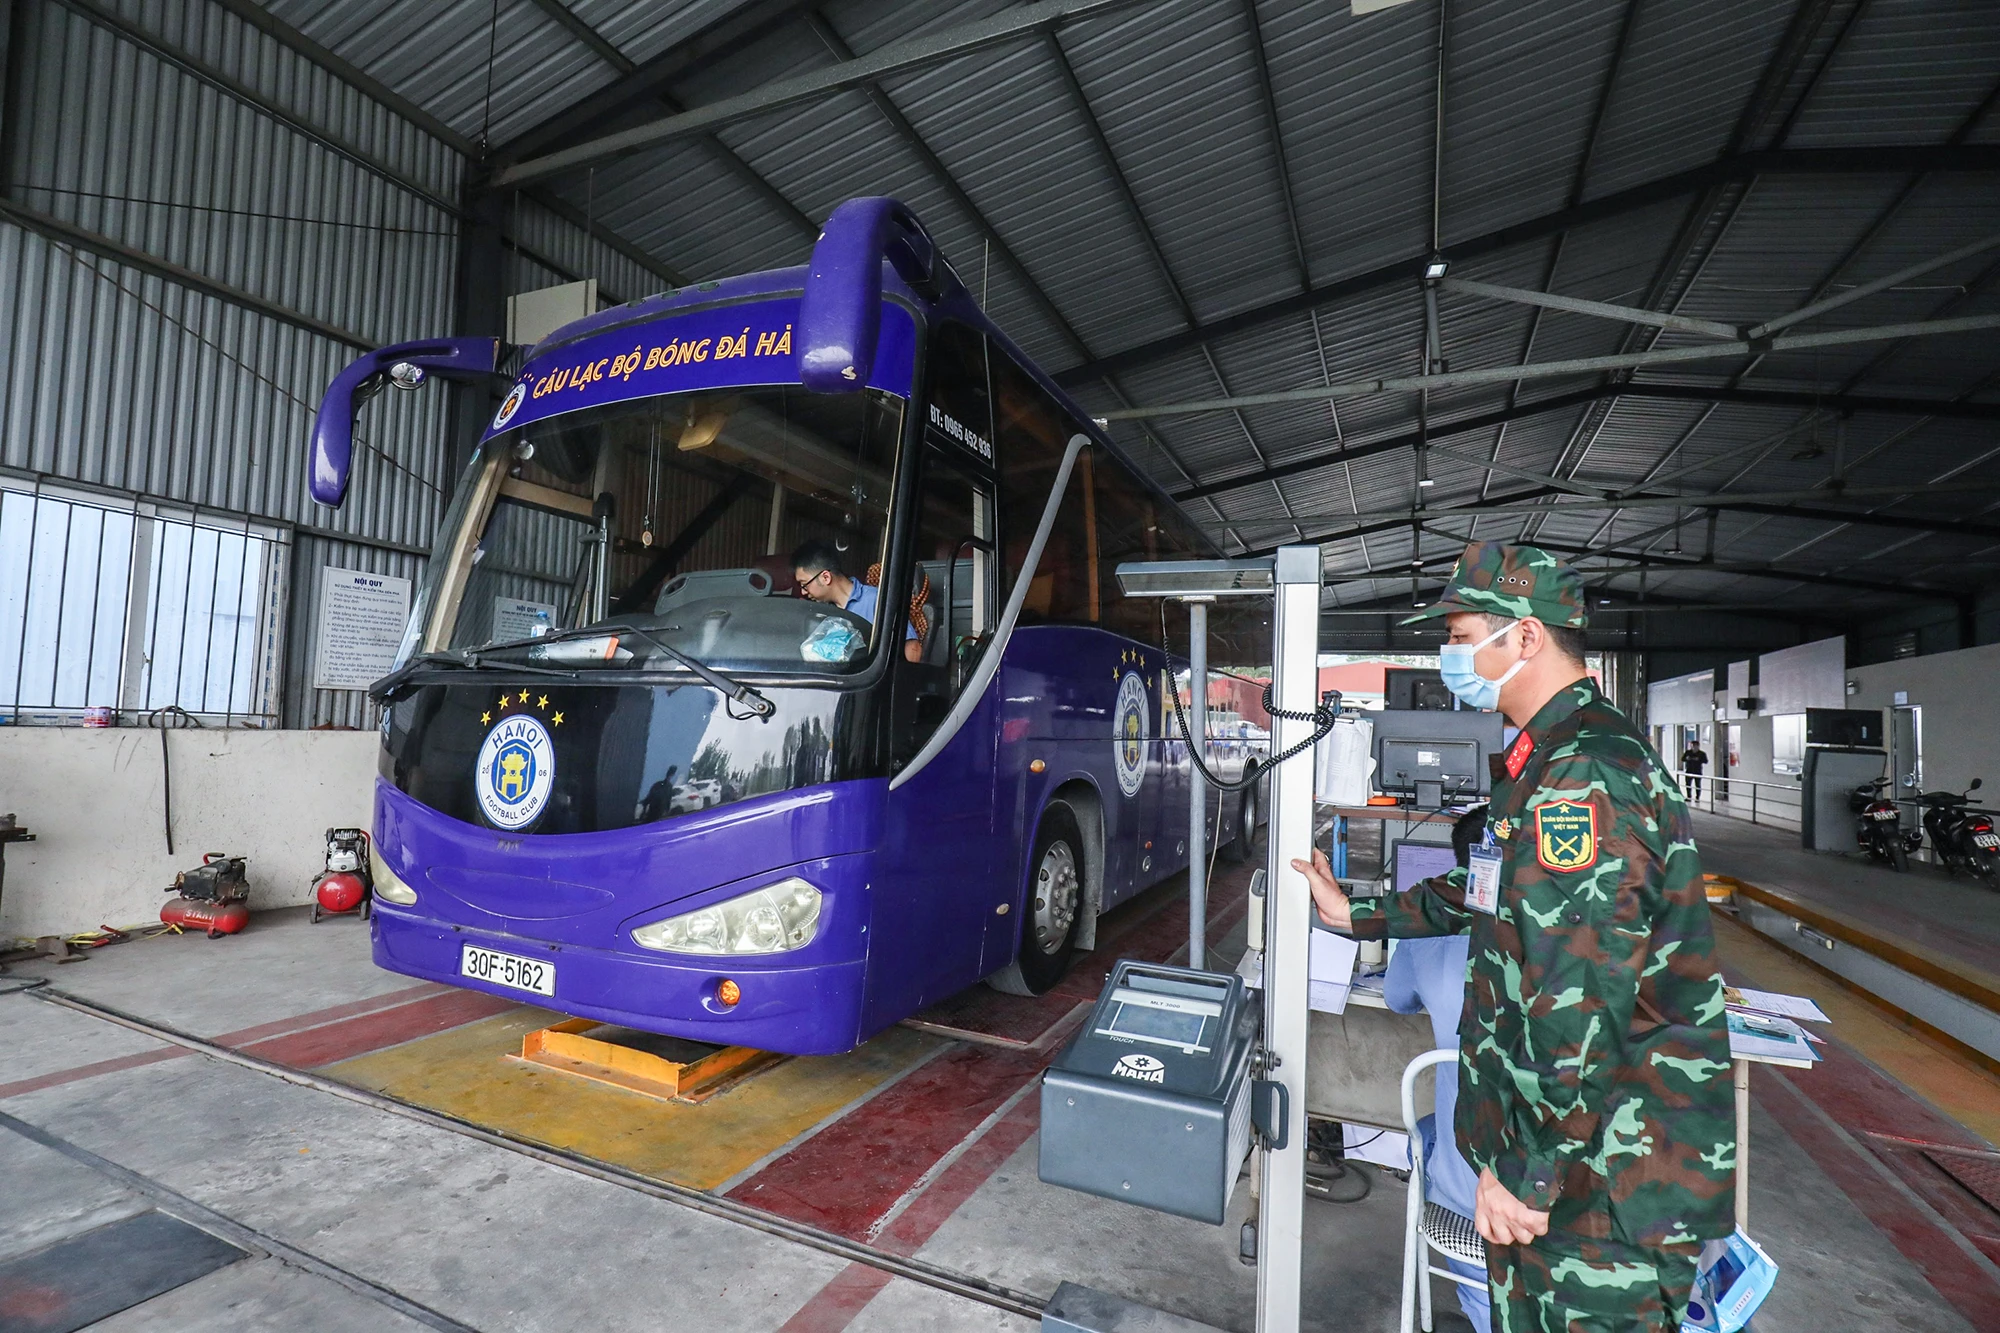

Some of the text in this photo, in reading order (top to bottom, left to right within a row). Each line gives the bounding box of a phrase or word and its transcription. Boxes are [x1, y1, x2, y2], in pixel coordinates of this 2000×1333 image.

[532, 366, 571, 399] CÂU
[569, 357, 608, 390] LẠC
[609, 346, 642, 381] BỘ
[644, 338, 711, 370] BÓNG
[714, 327, 750, 359] ĐÁ
[944, 414, 963, 441] 0965
[964, 428, 978, 451] 452
[354, 578, 383, 588] NỘI QUY
[492, 722, 543, 749] HANOI
[538, 769, 547, 777] 06
[485, 794, 538, 820] FOOTBALL CLUB
[467, 950, 544, 991] 30F-5162
[1109, 1035, 1135, 1044] TOUCH
[1111, 1060, 1165, 1084] MAHA
